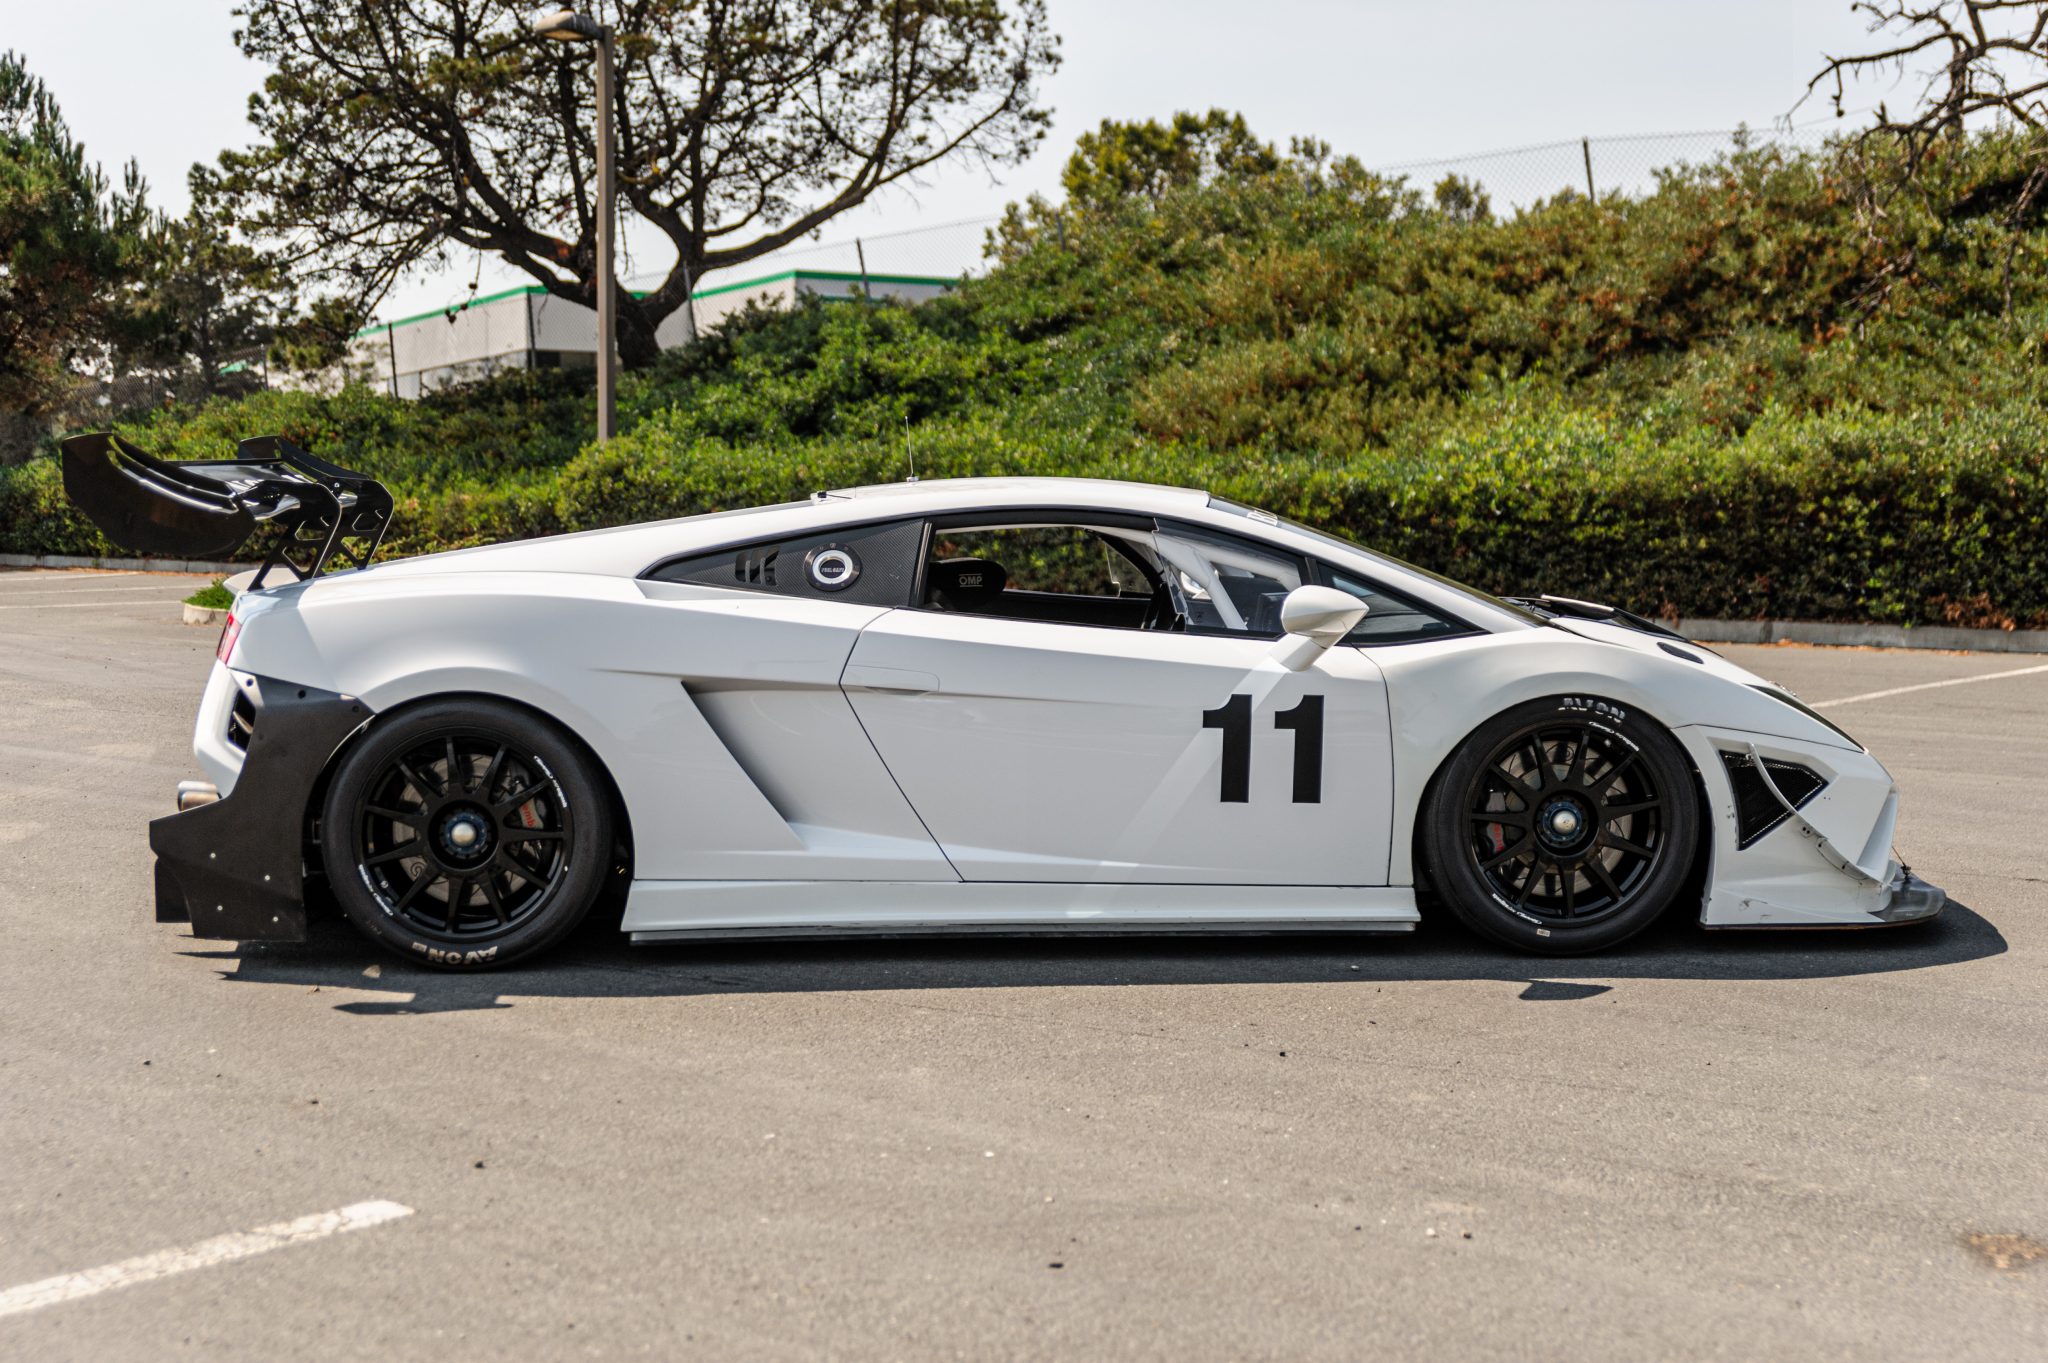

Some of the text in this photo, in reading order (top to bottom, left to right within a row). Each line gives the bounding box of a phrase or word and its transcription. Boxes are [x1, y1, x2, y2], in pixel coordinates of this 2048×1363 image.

[959, 576, 982, 585] OMP
[1202, 694, 1325, 803] 11
[427, 945, 498, 965] AVON
